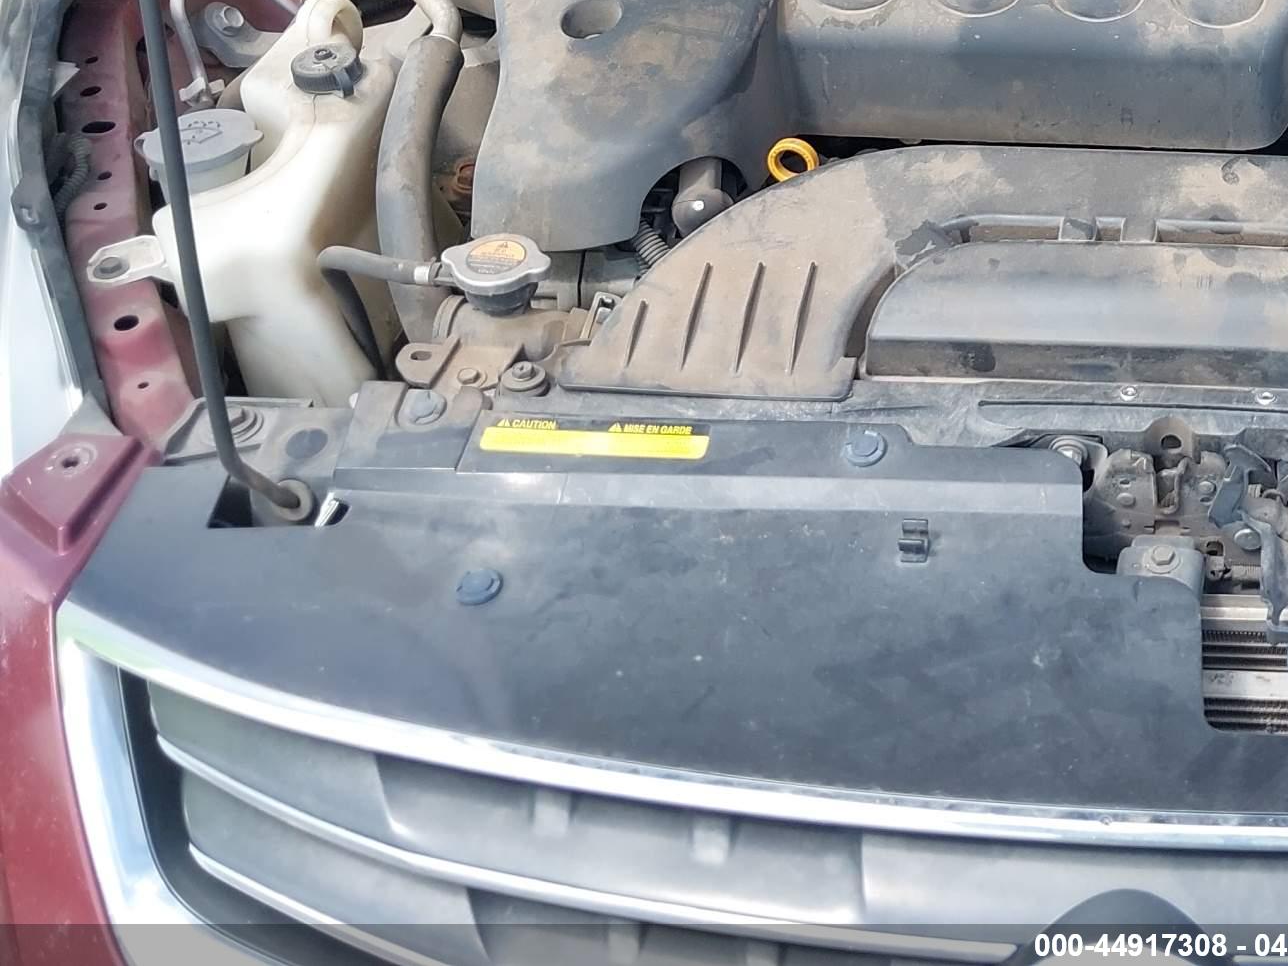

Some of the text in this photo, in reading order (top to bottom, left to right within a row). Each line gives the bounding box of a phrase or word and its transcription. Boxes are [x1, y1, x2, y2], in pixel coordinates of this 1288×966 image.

[512, 418, 557, 430] CAUTION
[623, 423, 694, 435] MISE EN GARDE
